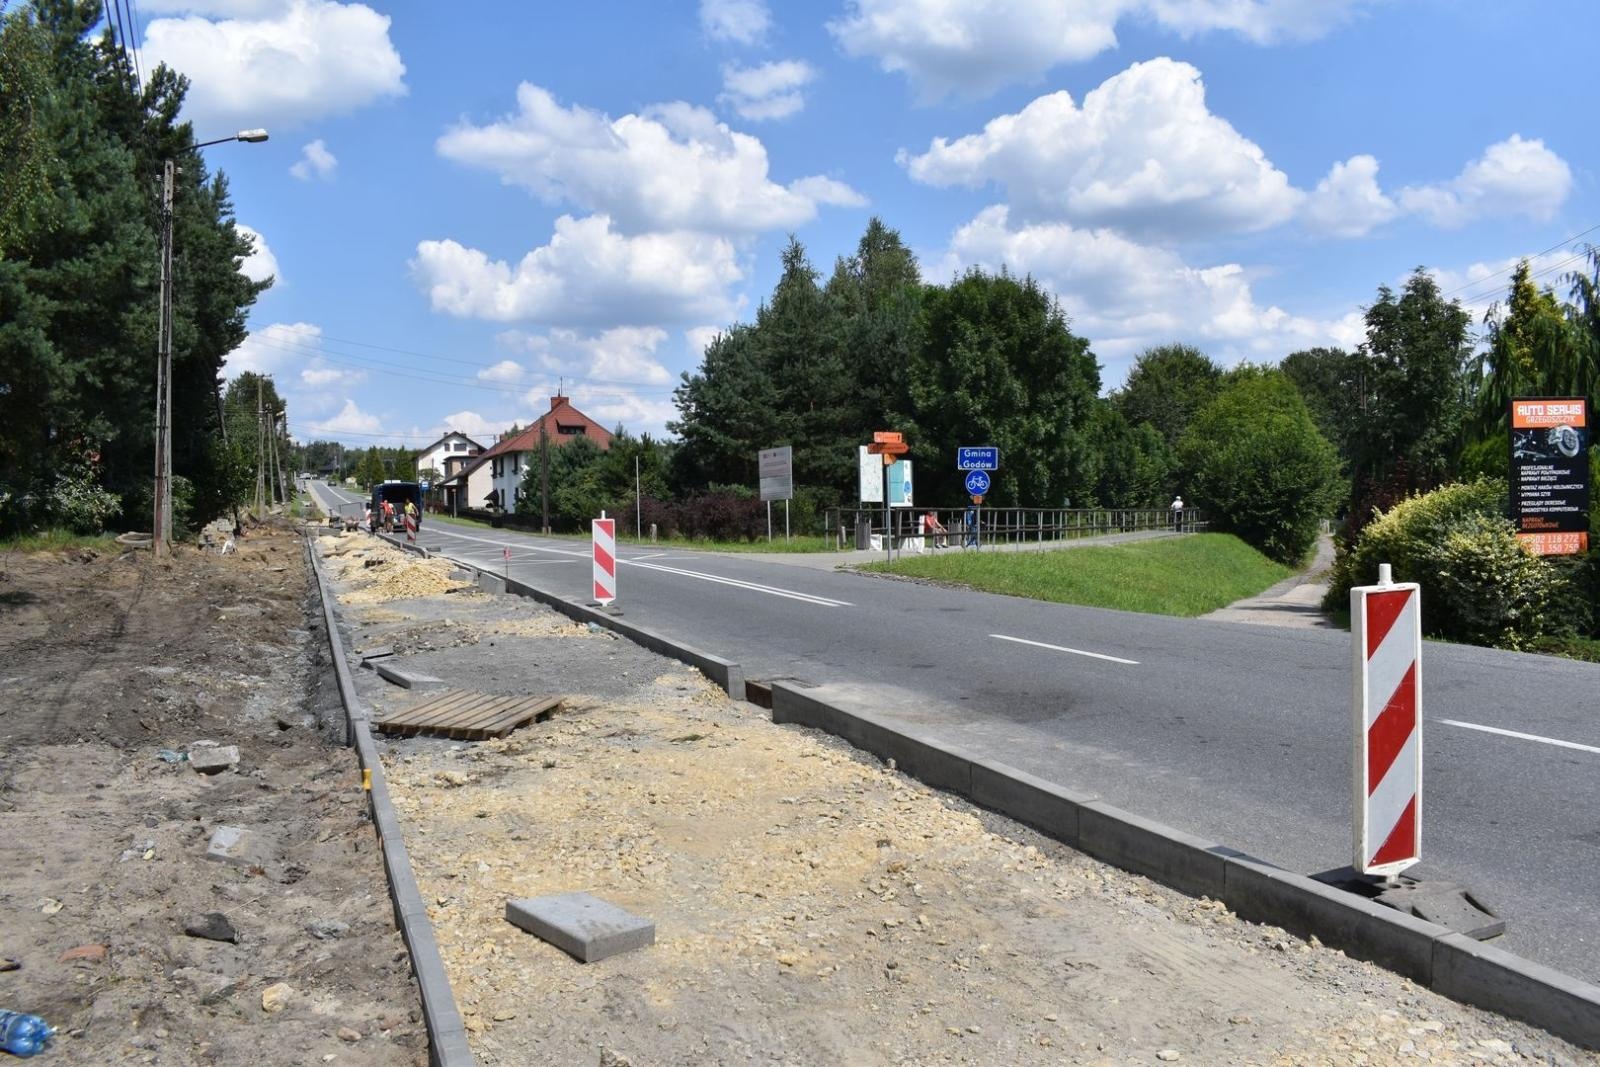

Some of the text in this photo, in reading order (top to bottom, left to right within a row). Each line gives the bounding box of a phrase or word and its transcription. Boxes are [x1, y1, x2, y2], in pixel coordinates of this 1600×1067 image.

[1517, 404, 1581, 415] AUTO SERWIS
[964, 449, 991, 457] Gmina
[963, 459, 992, 468] Godów
